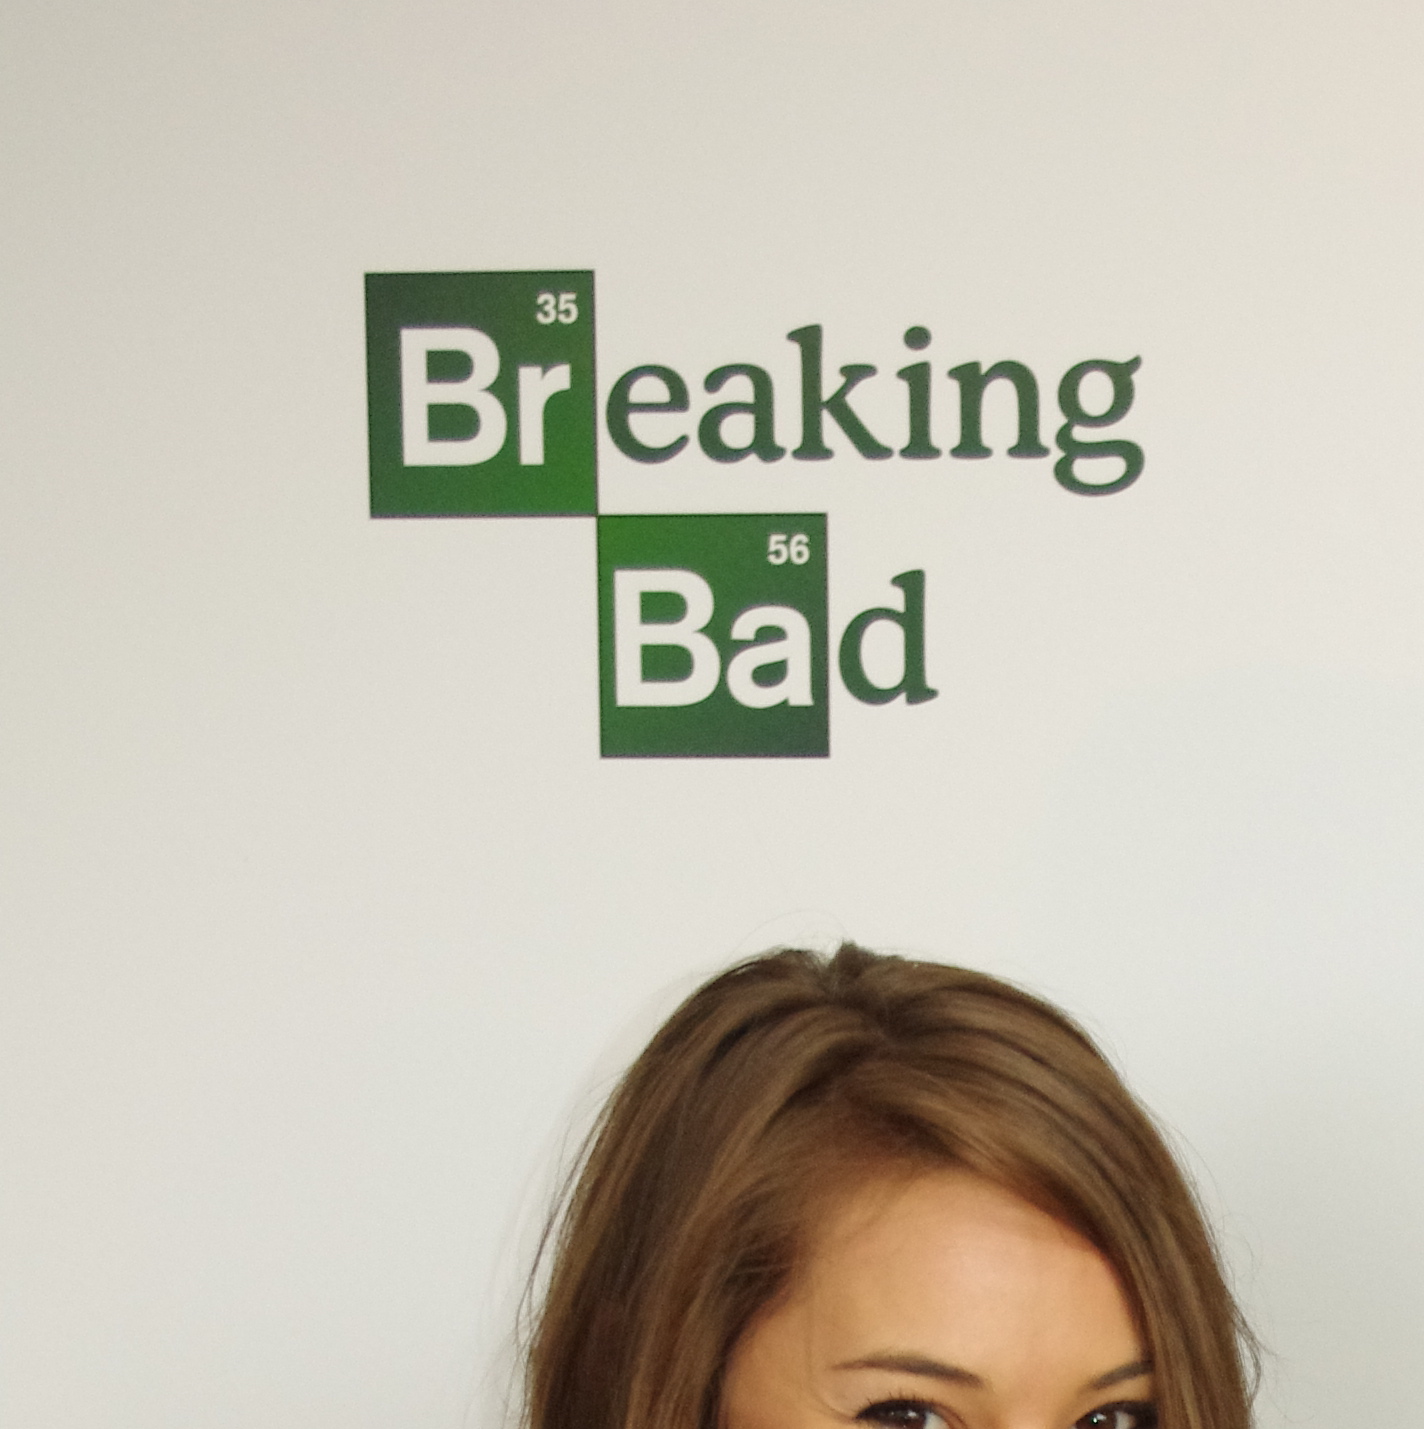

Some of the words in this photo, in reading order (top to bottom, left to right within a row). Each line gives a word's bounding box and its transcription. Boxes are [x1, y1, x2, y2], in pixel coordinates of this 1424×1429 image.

[536, 292, 579, 325] 35
[401, 324, 1145, 496] Breaking
[767, 534, 810, 564] 56
[613, 568, 939, 708] Bad
